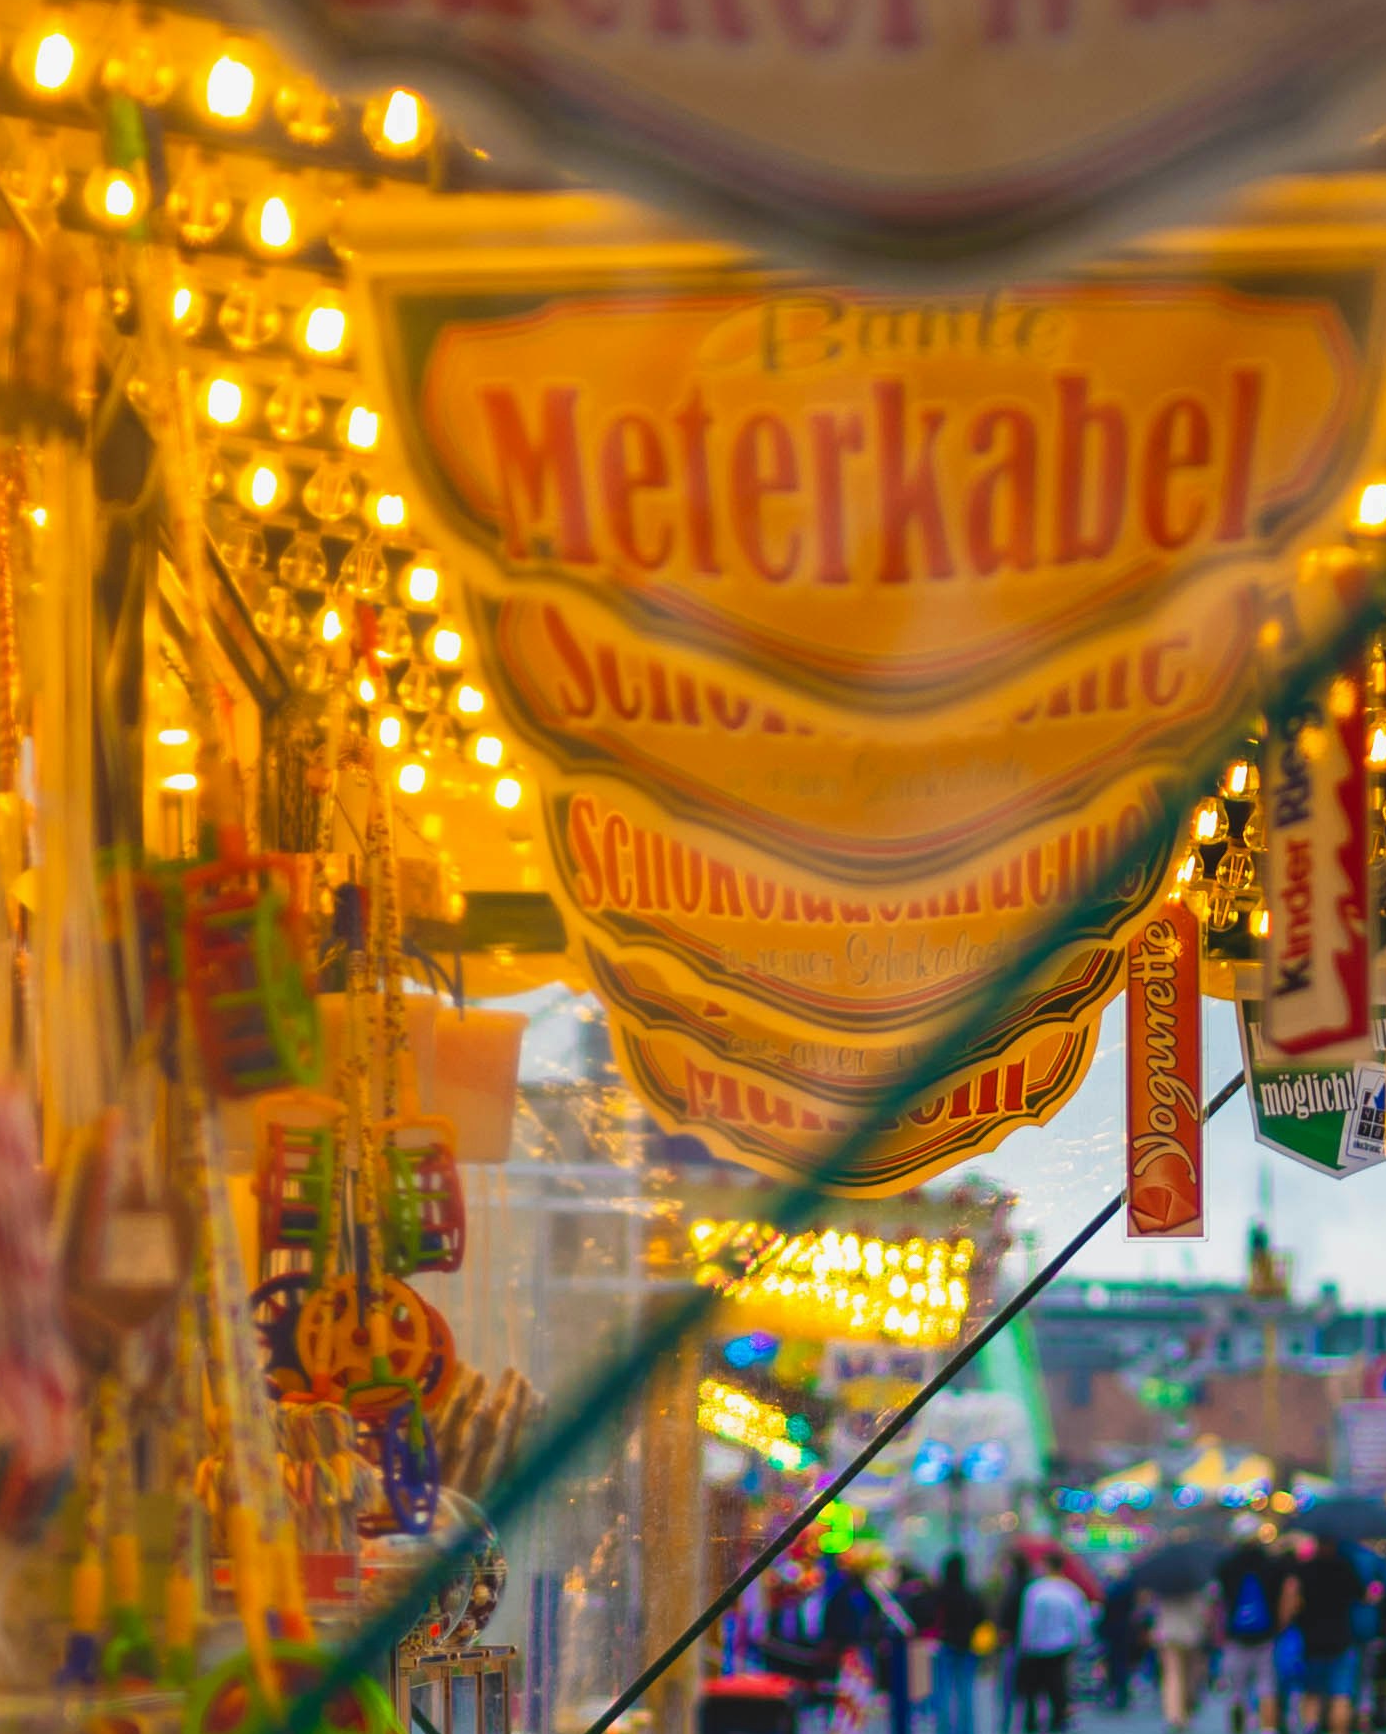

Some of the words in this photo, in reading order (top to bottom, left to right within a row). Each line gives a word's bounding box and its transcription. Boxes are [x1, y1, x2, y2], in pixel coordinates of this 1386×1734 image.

[478, 370, 1266, 586] Meterkabel
[1129, 918, 1199, 1185] Yogurette
[1260, 1070, 1358, 1120] möglich!
